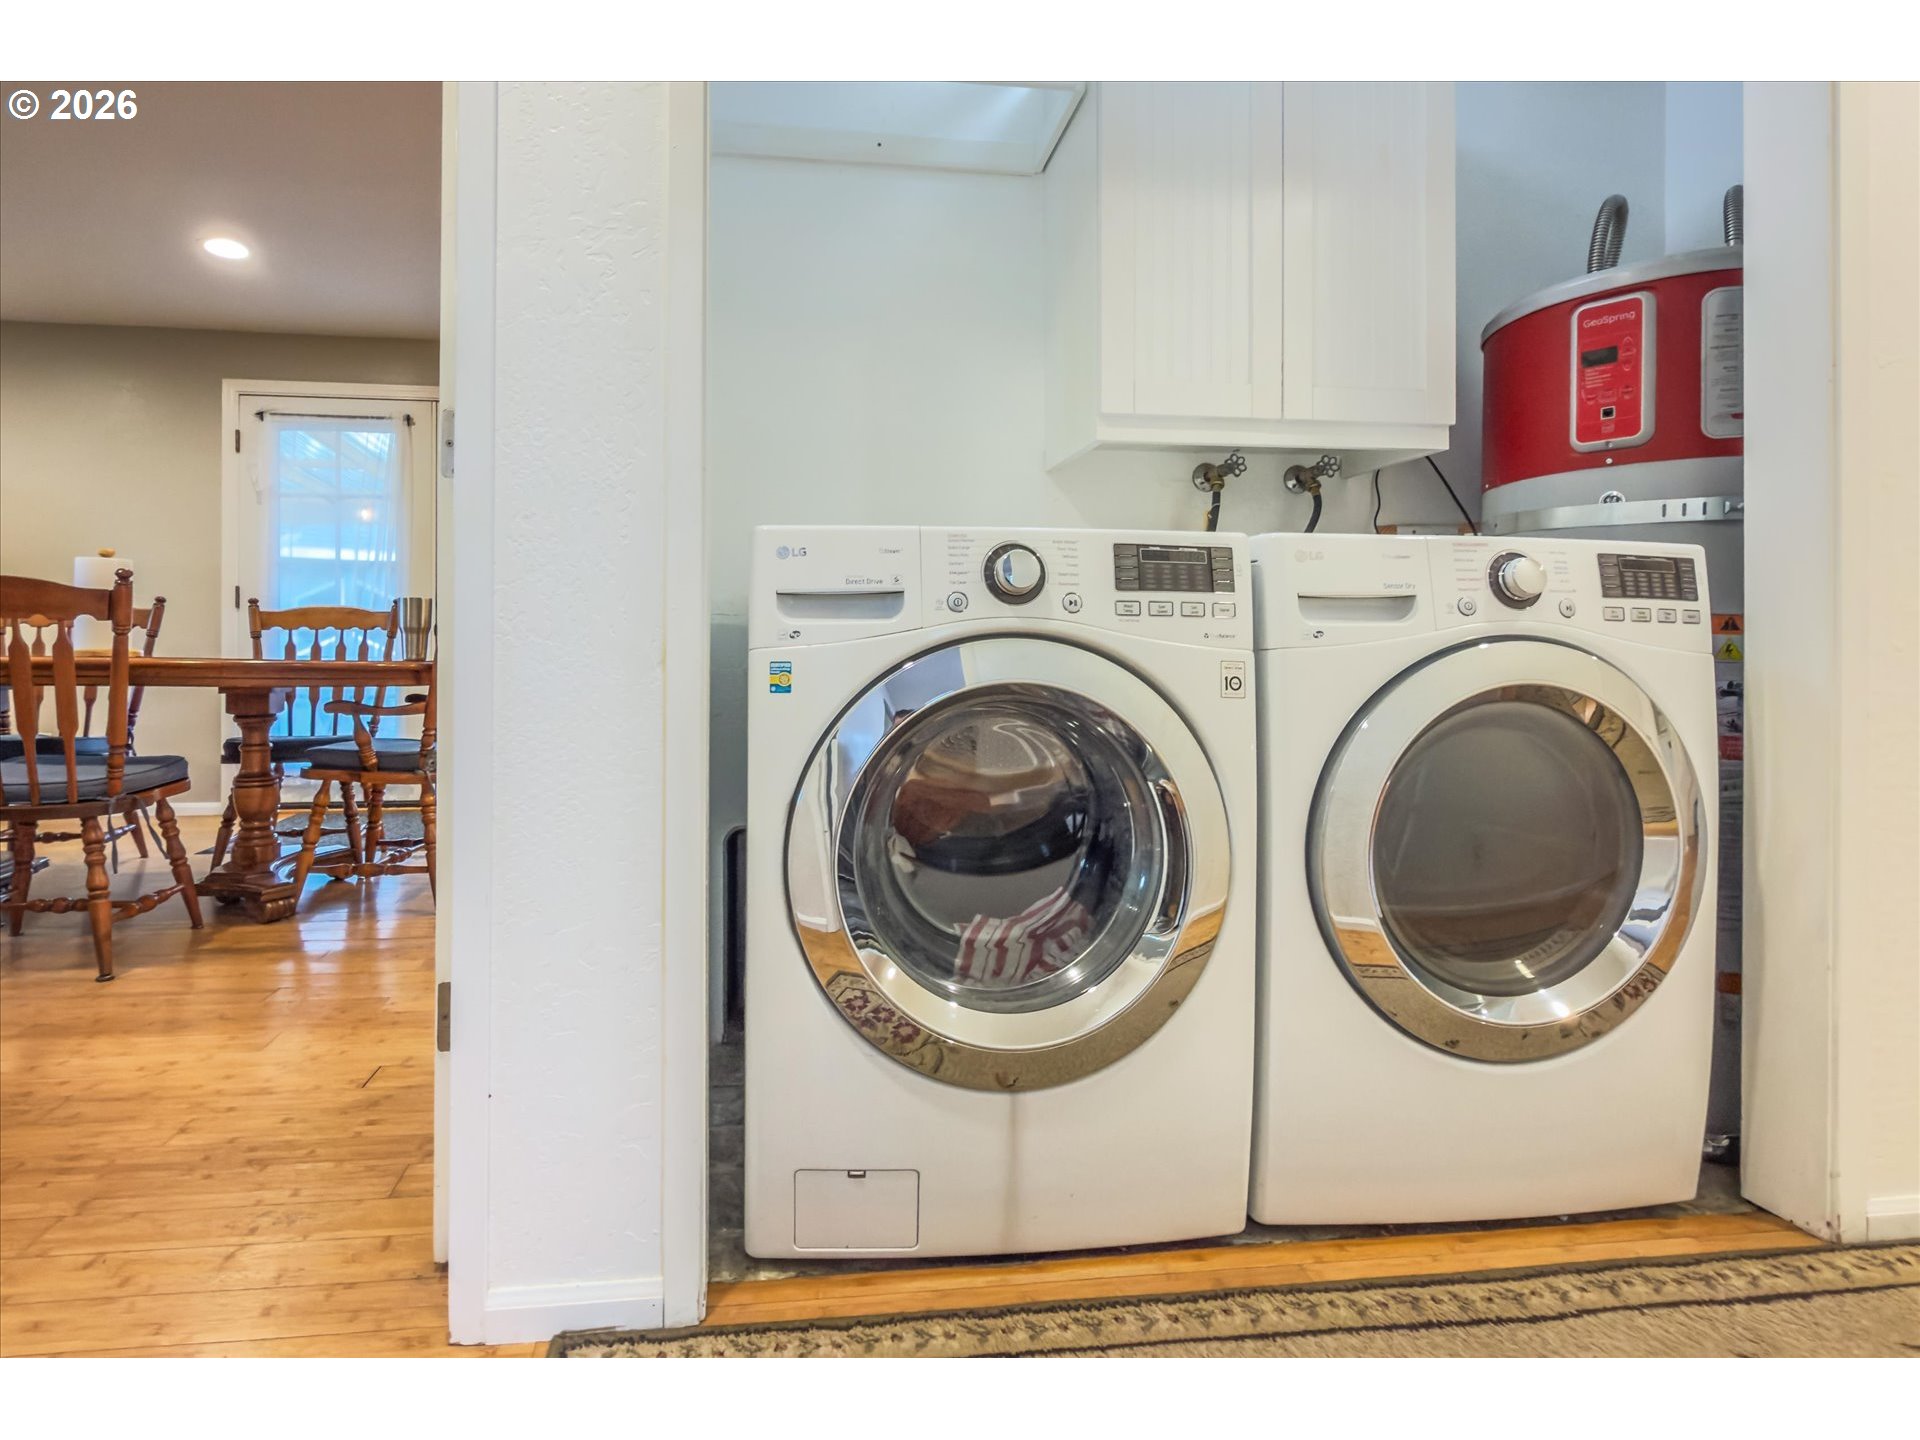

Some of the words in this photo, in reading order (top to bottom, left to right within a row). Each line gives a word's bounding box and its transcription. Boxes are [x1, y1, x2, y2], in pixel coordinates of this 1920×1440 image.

[1582, 310, 1636, 328] GeoSpring
[791, 547, 807, 557] LG
[1308, 551, 1324, 561] LG
[845, 577, 865, 585] Direct
[866, 577, 884, 585] Drive
[1383, 582, 1404, 590] Sensor
[1224, 675, 1243, 692] 10
